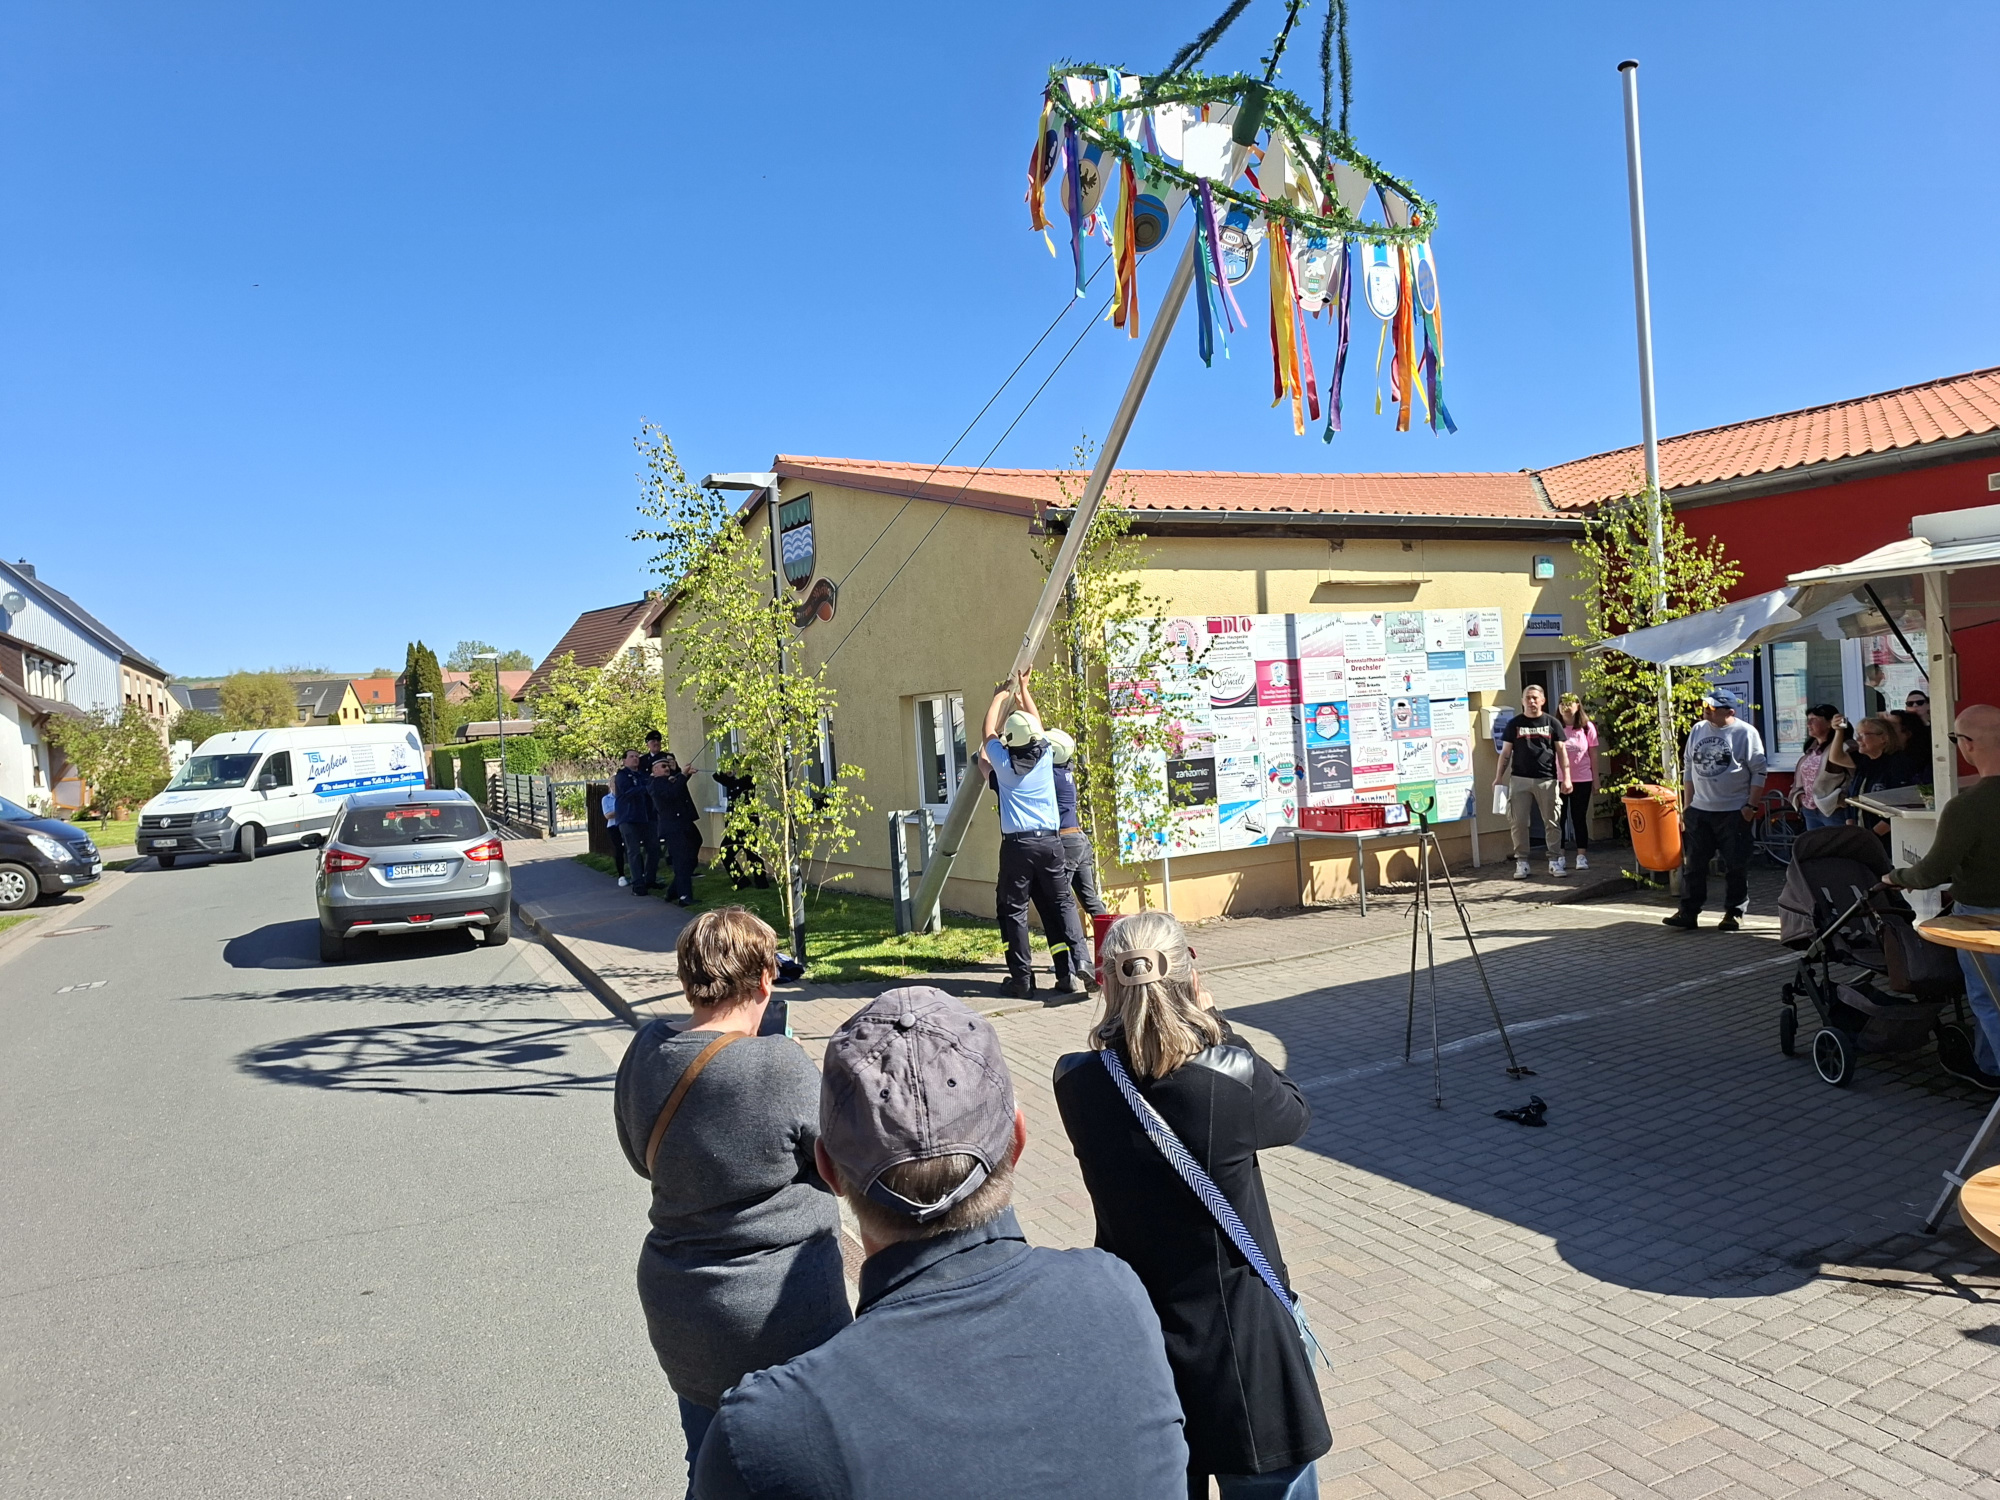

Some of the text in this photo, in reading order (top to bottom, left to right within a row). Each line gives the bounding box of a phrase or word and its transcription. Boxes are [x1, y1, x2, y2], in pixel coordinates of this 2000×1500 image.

[1225, 234, 1238, 243] 1891
[1527, 620, 1560, 631] Ausstellung
[1474, 651, 1494, 662] ESK
[1351, 664, 1381, 672] Drechsler
[303, 751, 326, 764] TSL
[307, 754, 348, 781] Langbein
[394, 863, 446, 875] SGH HK 23
